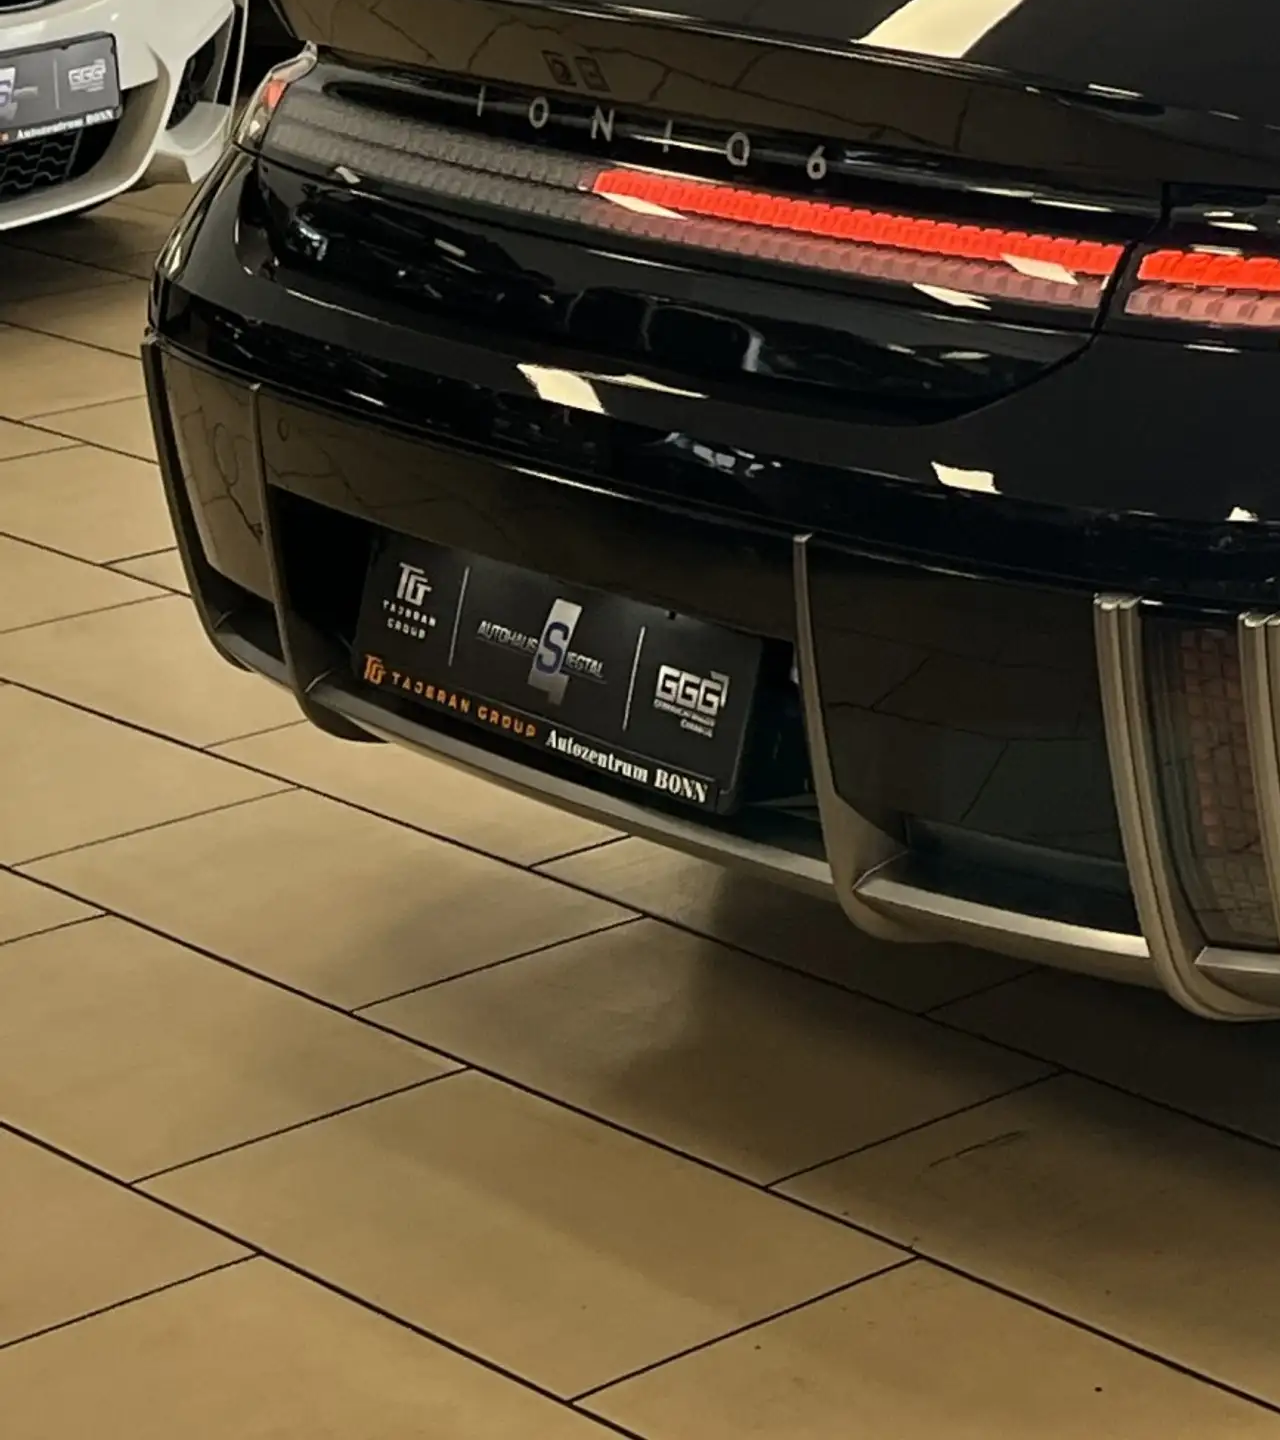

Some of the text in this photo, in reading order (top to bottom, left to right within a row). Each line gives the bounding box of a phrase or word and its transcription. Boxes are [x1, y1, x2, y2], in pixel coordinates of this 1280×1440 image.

[476, 85, 828, 180] IONIQ 6
[656, 664, 729, 716] GGG
[477, 705, 537, 738] GROUP
[545, 729, 649, 784] Autozentrum
[654, 767, 709, 804] BONN
